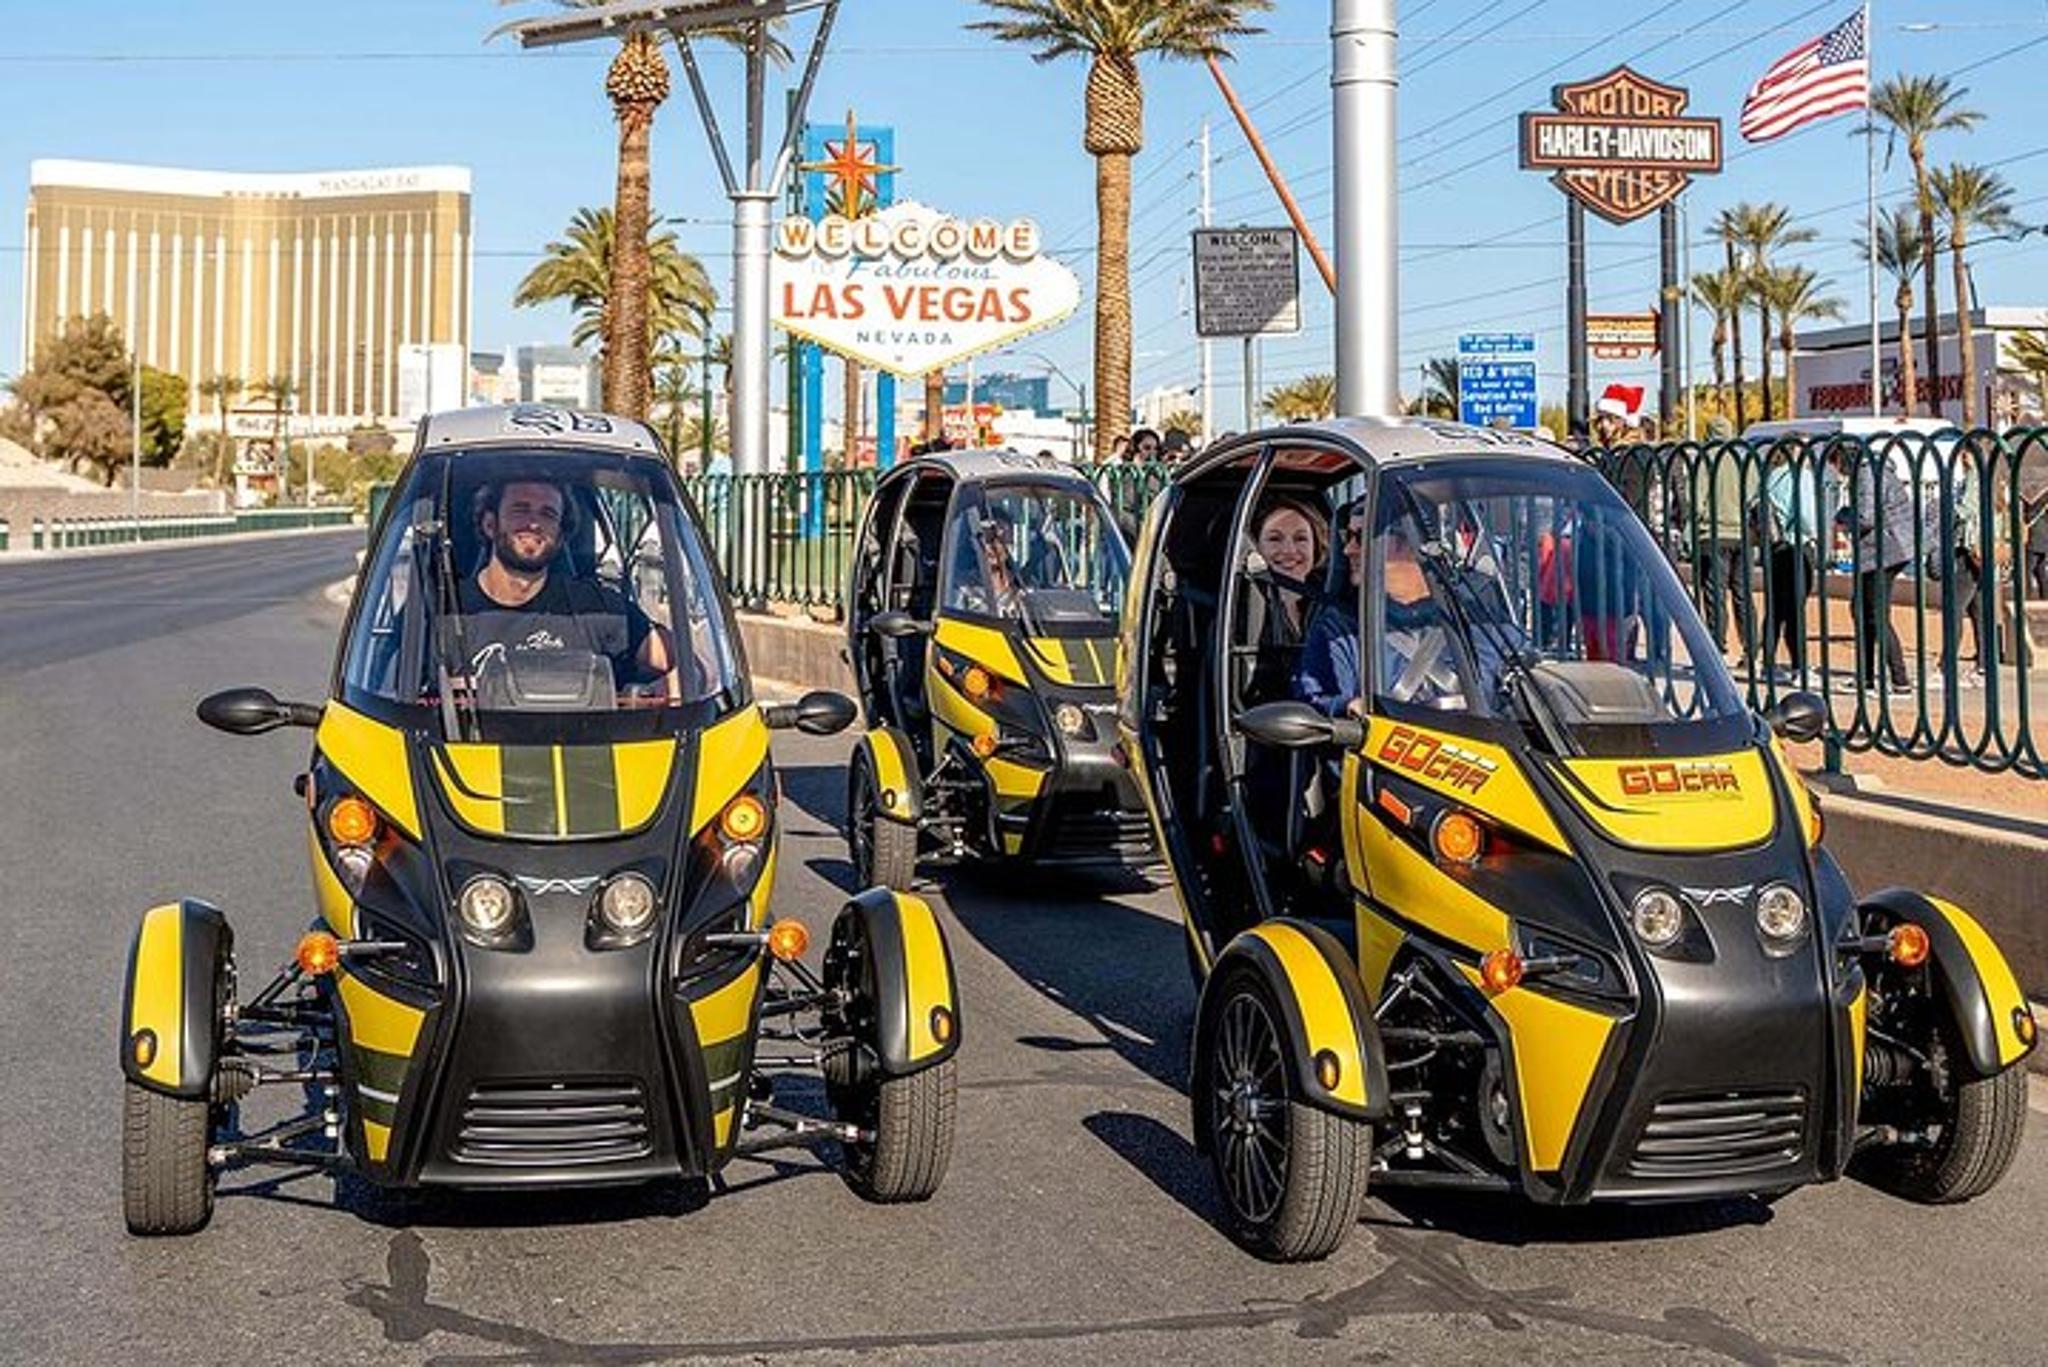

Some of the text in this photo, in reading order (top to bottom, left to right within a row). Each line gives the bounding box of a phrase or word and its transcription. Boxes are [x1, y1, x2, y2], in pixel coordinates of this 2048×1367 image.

[1580, 79, 1671, 116] MOTOR
[1539, 124, 1711, 160] HARLEY-DAVIDSON
[1578, 169, 1670, 208] CYCLES
[783, 223, 1032, 252] WELCOME
[1210, 233, 1280, 246] WELCOME
[846, 256, 1000, 281] Fabulous
[783, 282, 1032, 323] LAS VEGAS
[856, 330, 953, 345] NEVADA
